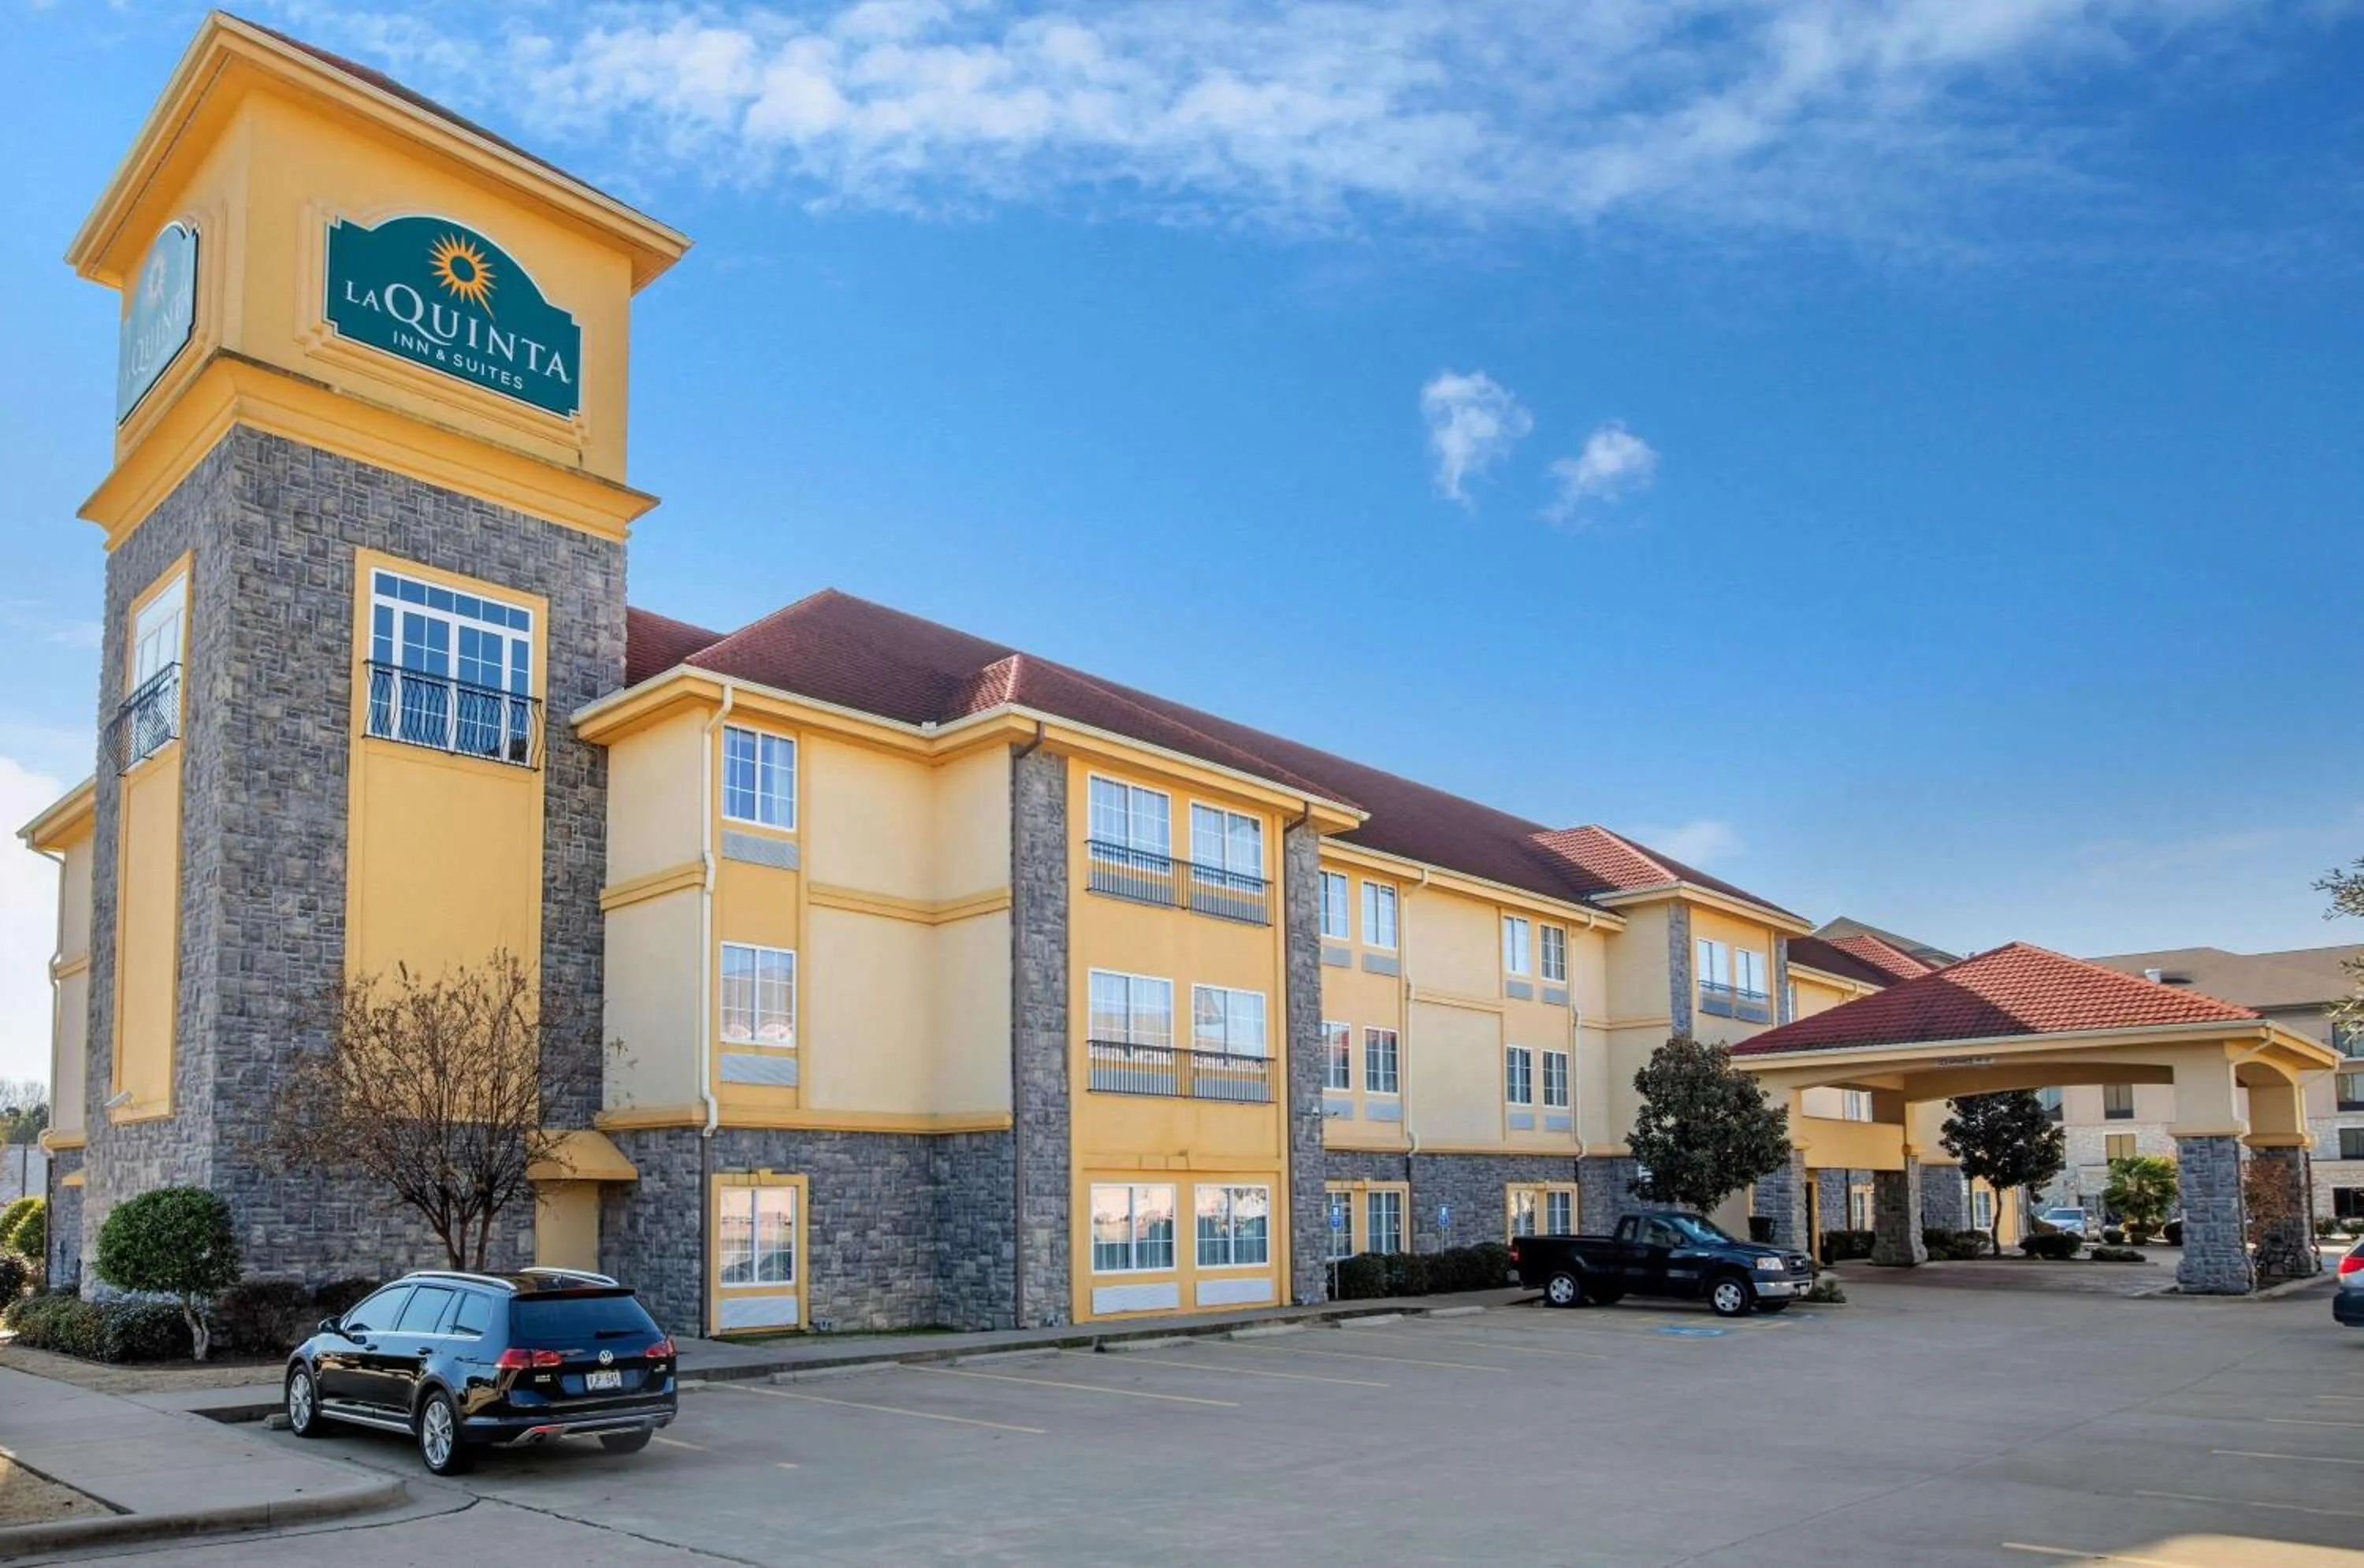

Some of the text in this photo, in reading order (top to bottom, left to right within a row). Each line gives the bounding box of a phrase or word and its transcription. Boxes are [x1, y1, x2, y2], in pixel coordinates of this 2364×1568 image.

[345, 280, 571, 385] LA QUINTA
[393, 329, 524, 390] INN & SUITES
